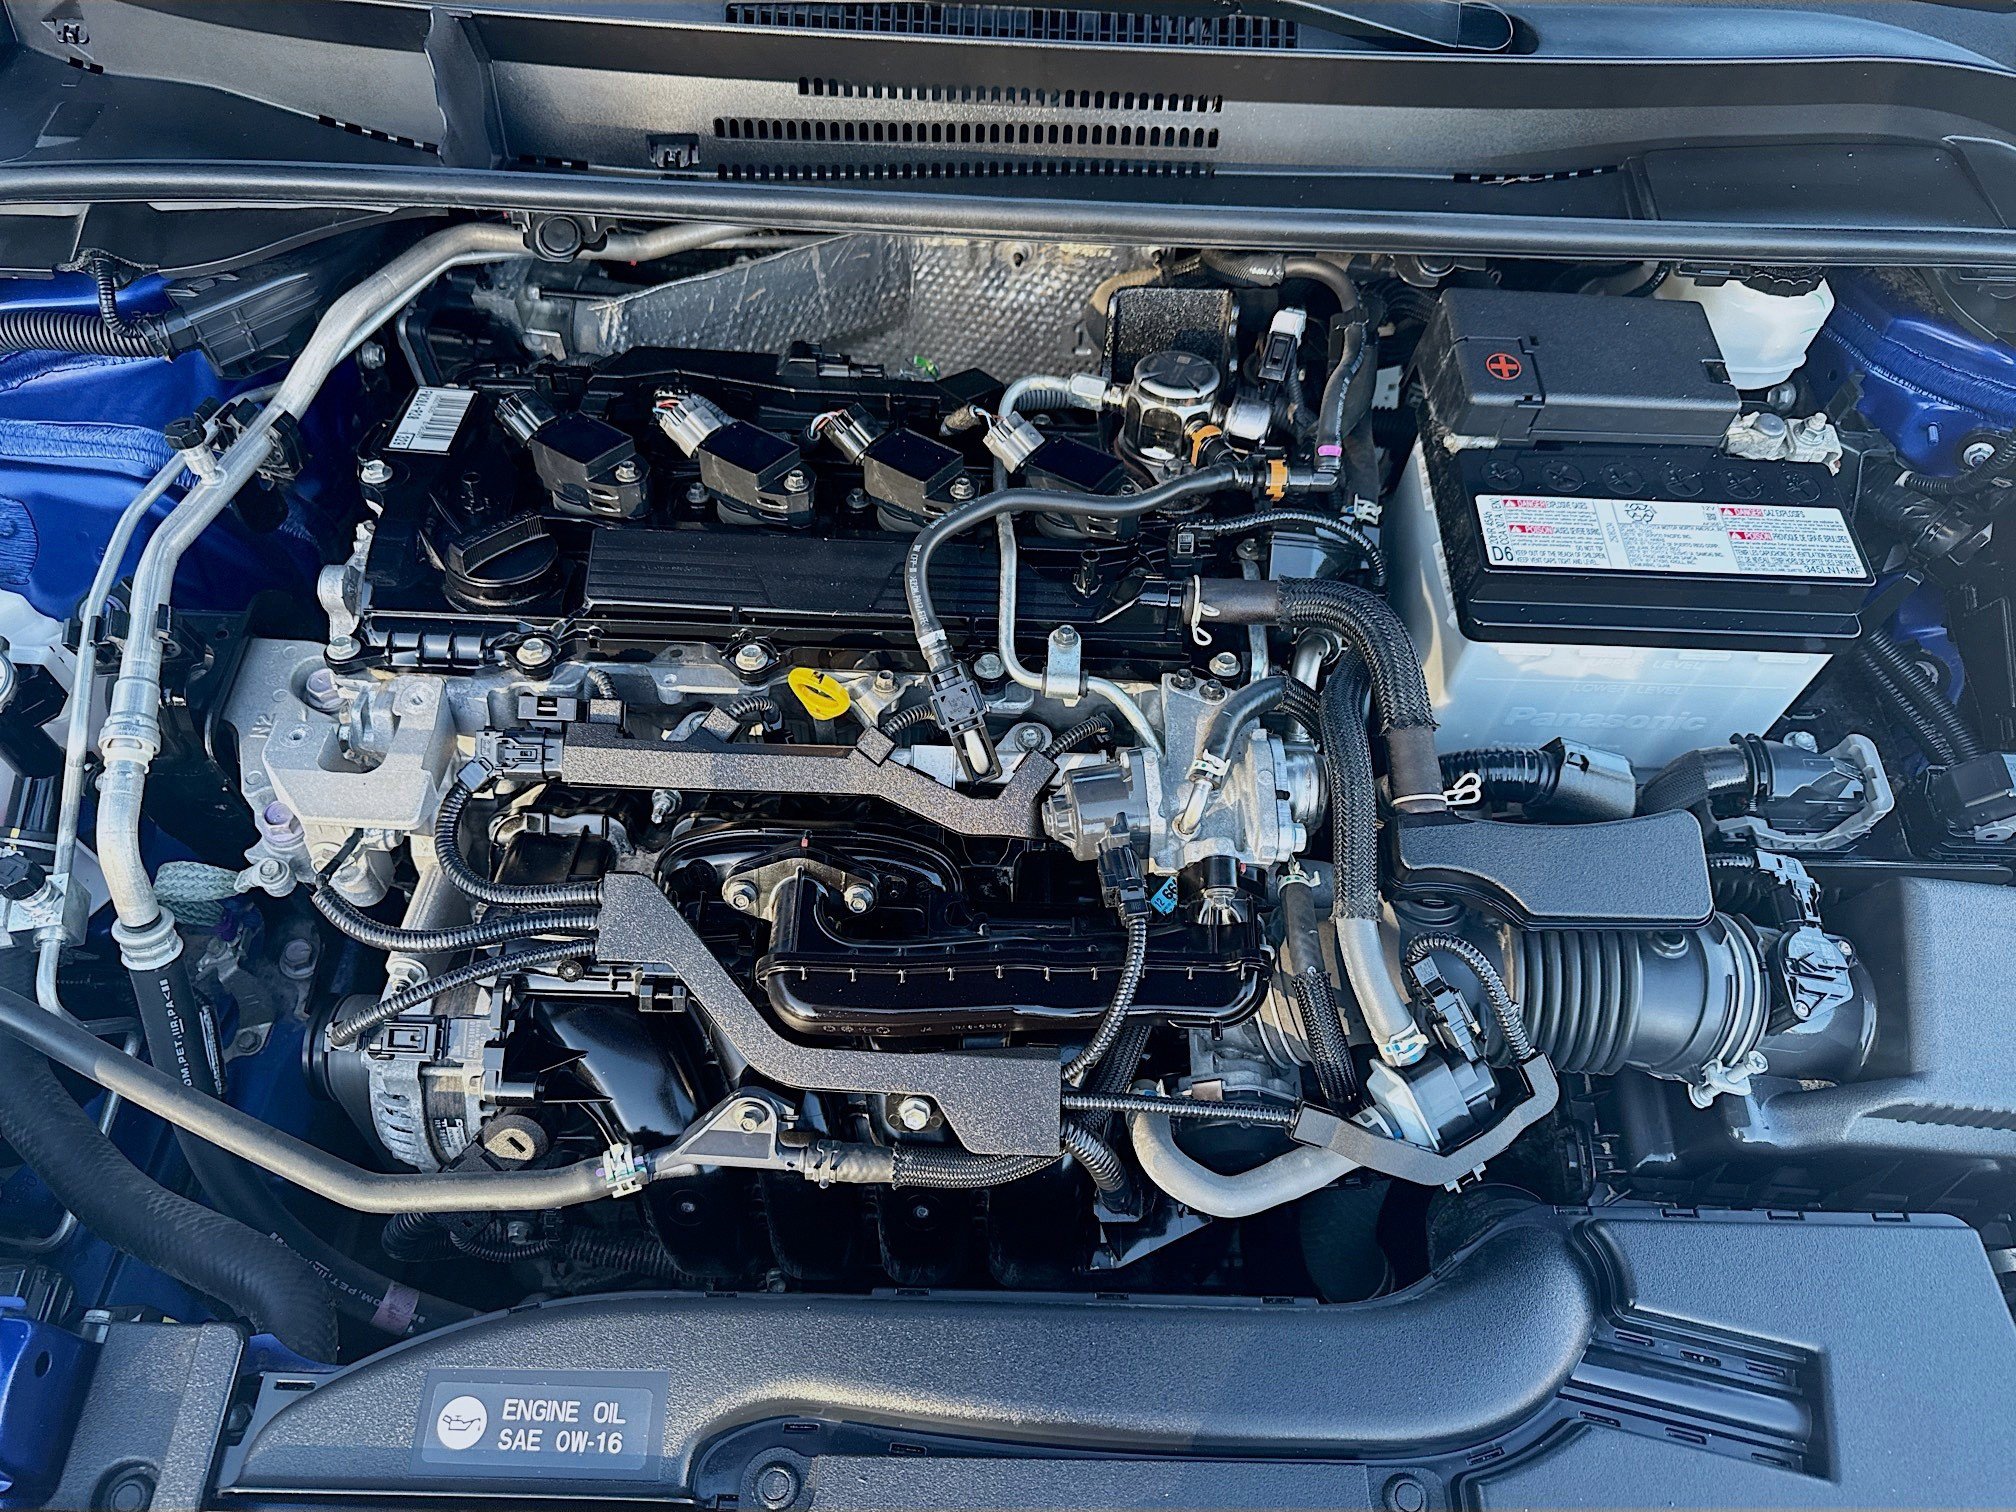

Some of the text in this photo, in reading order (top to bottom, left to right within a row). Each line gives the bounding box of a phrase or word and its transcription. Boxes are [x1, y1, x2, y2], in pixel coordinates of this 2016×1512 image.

[1518, 499, 1546, 508] DANGER
[1734, 508, 1763, 516] DANGER
[1525, 525, 1553, 533] POISON
[1743, 532, 1772, 540] POISON
[1491, 545, 1514, 561] D6
[1803, 565, 1862, 574] 345LN1-MF
[1652, 659, 1704, 671] LEVEL
[1572, 683, 1683, 696] LOWER LEVEL
[1503, 706, 1708, 732] Panasonic
[1154, 897, 1165, 908] 12
[502, 1398, 626, 1424] ENGINE OIL
[497, 1428, 624, 1454] SAE 0W-16
